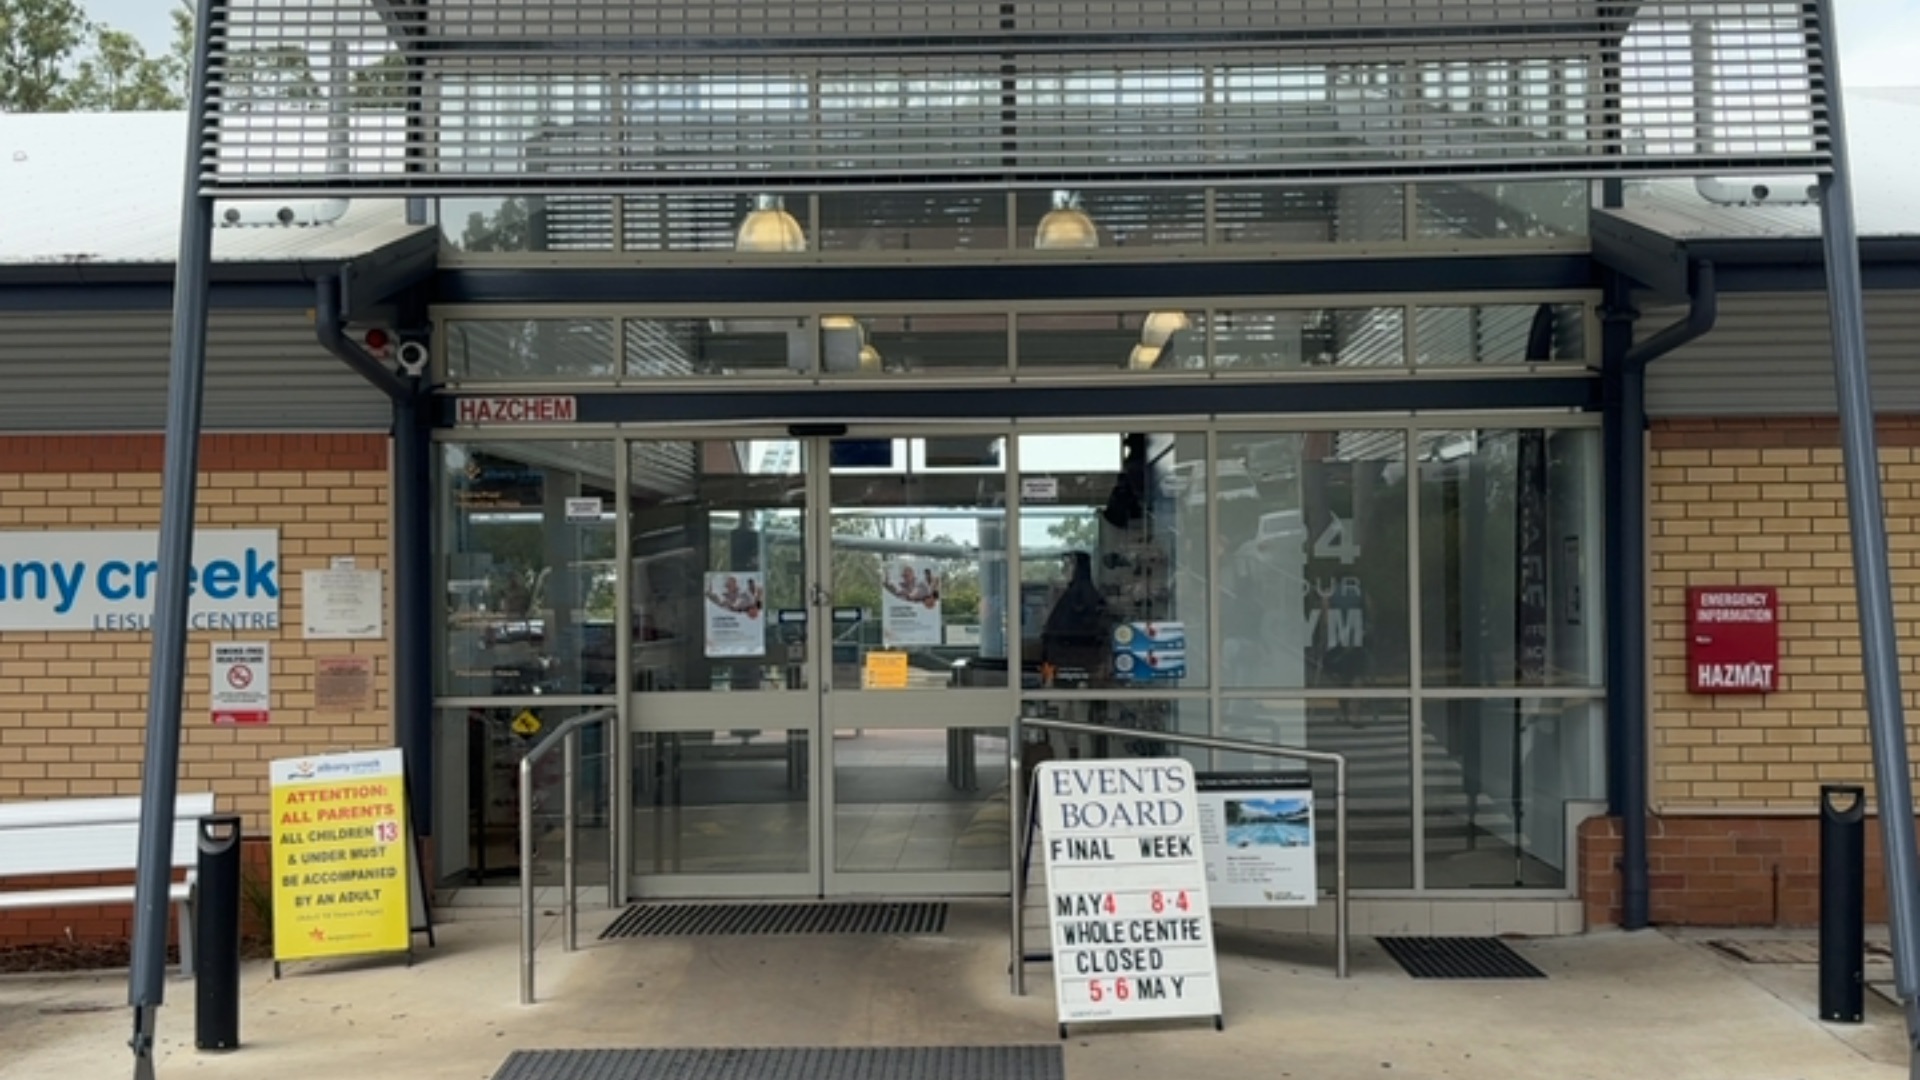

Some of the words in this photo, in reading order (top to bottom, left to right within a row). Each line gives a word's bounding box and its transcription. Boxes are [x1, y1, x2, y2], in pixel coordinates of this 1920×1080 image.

[460, 398, 572, 421] HAZCHEM
[1701, 592, 1768, 607] EMERGENCY
[93, 613, 155, 630] LEISU
[192, 612, 277, 630] CENTRE
[1696, 608, 1772, 623] INFORMATION
[1698, 663, 1773, 687] HAZMAT
[1052, 766, 1185, 796] EVENTS
[287, 784, 388, 805] ATTENTION:
[281, 810, 312, 825] ALL
[317, 803, 395, 821] PARENTS
[1061, 799, 1184, 828] BOARD
[280, 832, 304, 844] ALL
[307, 826, 374, 842] CHILDREN
[377, 822, 398, 841] 13
[288, 854, 297, 865] &
[301, 849, 347, 864] UNDER
[350, 846, 386, 859] MUST
[1051, 838, 1114, 860] FINAL
[1139, 835, 1193, 858] WEEK
[282, 875, 298, 887] BE
[303, 867, 397, 884] ACCOMPANIED
[295, 895, 312, 907] BY
[317, 894, 334, 905] AN
[339, 889, 382, 903] ADULT
[1064, 921, 1126, 945] WHOLE
[1076, 948, 1164, 974] CLOSED
[1137, 976, 1184, 999] MAY
